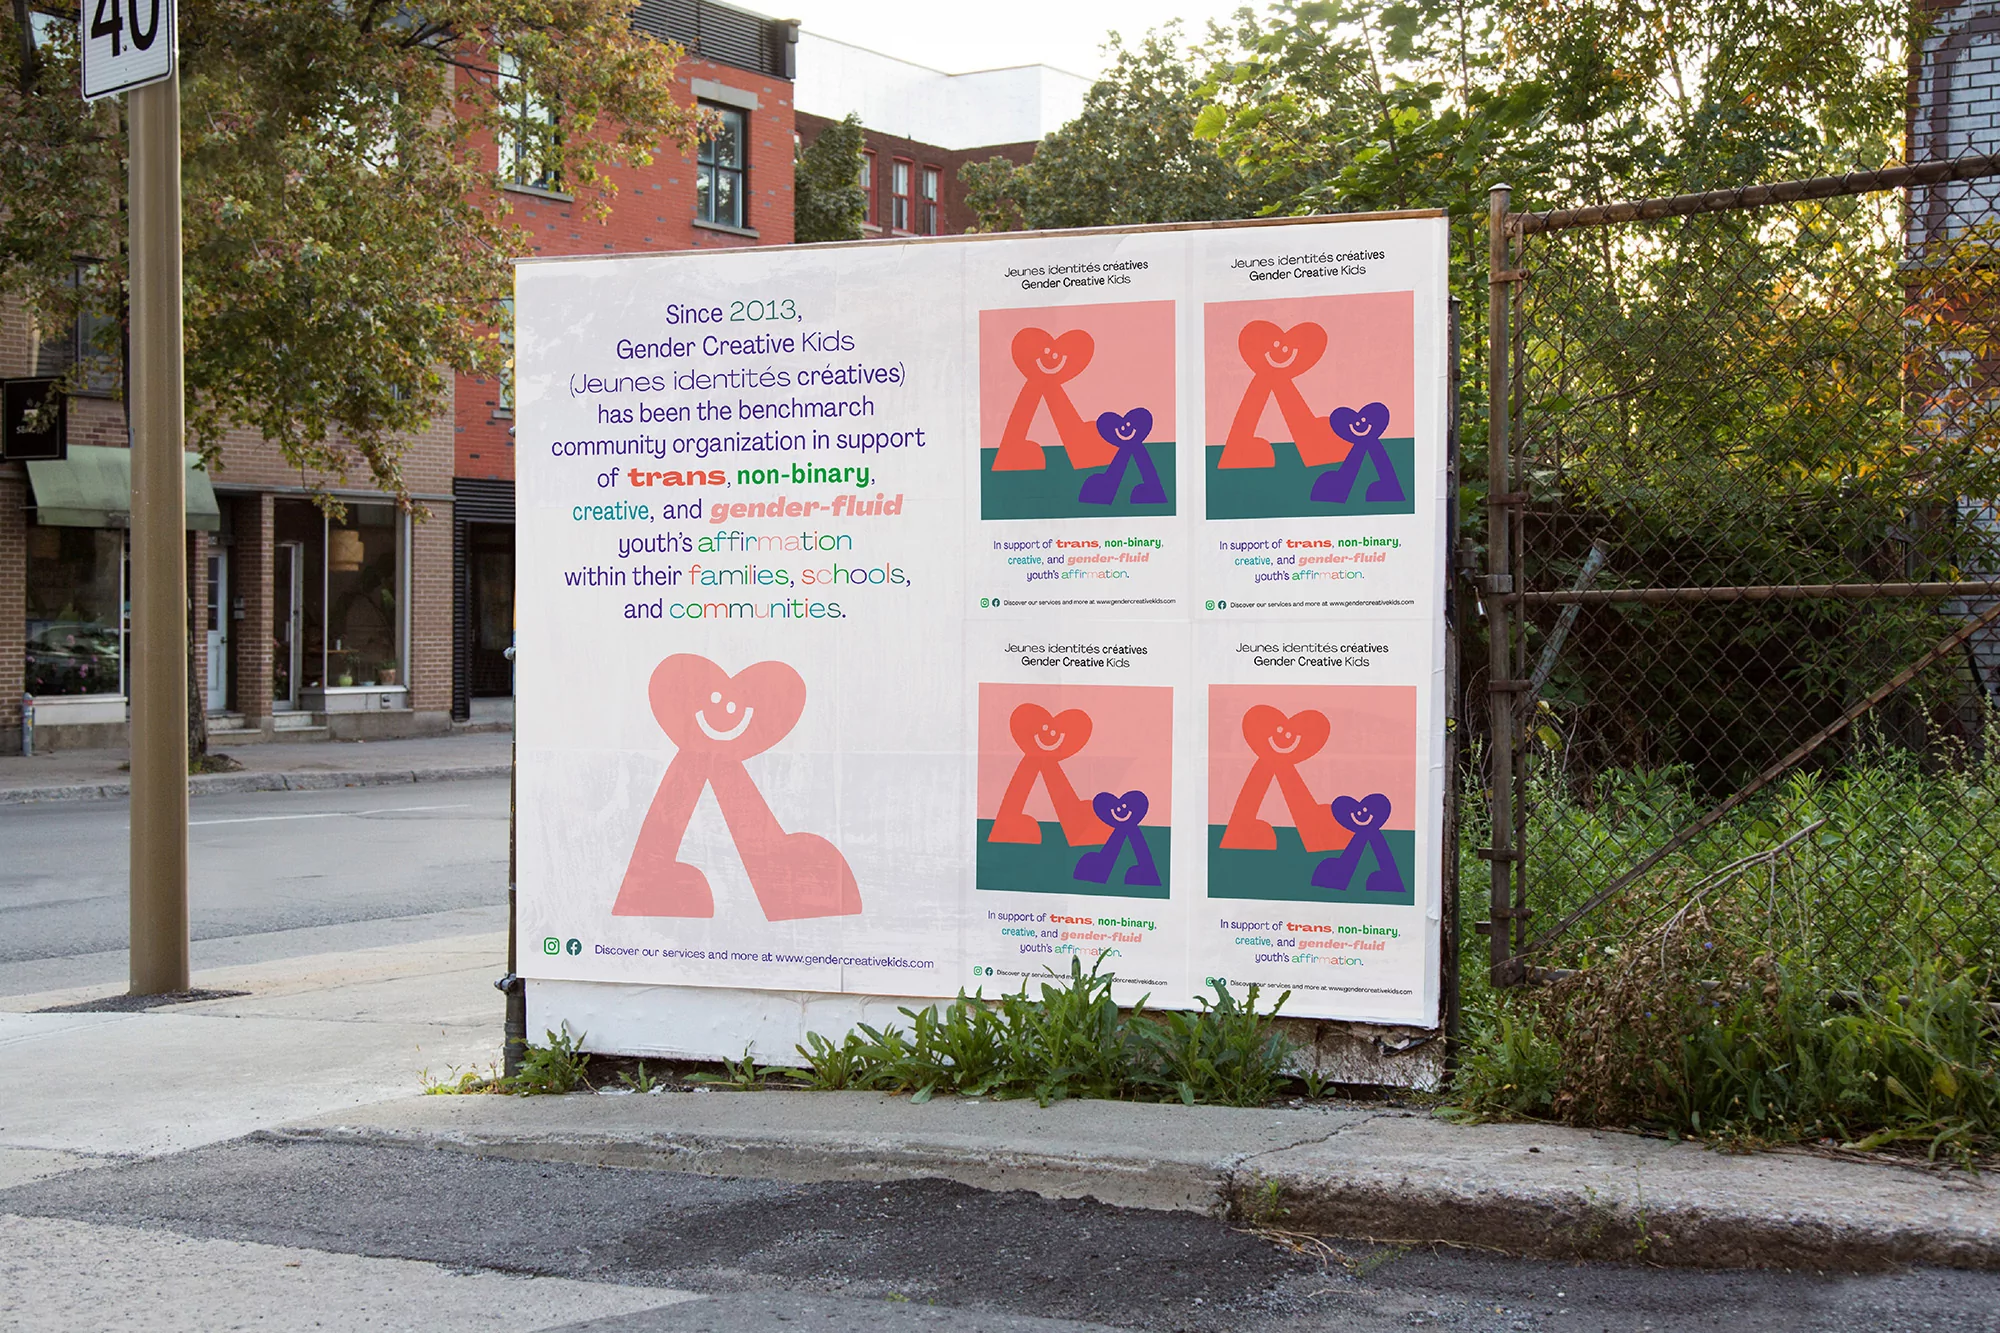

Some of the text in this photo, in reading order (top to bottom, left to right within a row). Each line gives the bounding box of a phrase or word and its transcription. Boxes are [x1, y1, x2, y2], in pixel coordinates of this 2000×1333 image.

[91, 0, 160, 57] 40
[1231, 250, 1385, 268] Jeunes identités créatives
[1004, 260, 1148, 277] Jeunes identités créatives
[1249, 264, 1366, 281] Gender Creative Kids
[1022, 274, 1131, 290] Gender Creative Kids
[666, 299, 802, 324] Since 2013,
[617, 330, 855, 359] Gender Creative Kids
[570, 361, 905, 398] (Jeunes identités créatives)
[599, 395, 874, 423] has been the benchmarch
[552, 428, 925, 459] community organization in support
[597, 462, 875, 488] of trans, non-binary,
[573, 493, 903, 524] creative, and gender-fluid
[618, 531, 852, 558] youth's affirmation
[994, 537, 1163, 551] In support of trans, non-binary,
[1220, 536, 1401, 552] In support of trans, non-binary,
[1008, 552, 1149, 566] creative, and gender-fluid
[1235, 552, 1386, 566] creative, and gender-fluid
[564, 563, 910, 588] within their families, schools,
[1027, 569, 1129, 582] youth's affirmation.
[1255, 570, 1364, 583] youth's affirmation.
[624, 598, 846, 619] and communities.
[1096, 598, 1176, 606] www.gendercreativekids.com
[1230, 601, 1255, 609] Discover
[1268, 600, 1291, 608] services
[1293, 600, 1304, 608] and
[1005, 643, 1148, 655] Jeunes identités créatives
[1236, 642, 1389, 653] Jeunes identités créatives
[1021, 656, 1130, 668] Gender Creative Kids
[1254, 656, 1370, 667] Gender Creative Kids
[988, 910, 1156, 931] In support of trans, non-binary,
[1221, 919, 1400, 938] In support of trans, non-binary,
[1002, 928, 1142, 942] creative, and gender-fluid
[1235, 936, 1385, 950] creative, and gender-fluid
[1020, 943, 1052, 954] youth's
[595, 945, 639, 955] Discover
[662, 949, 705, 959] services
[708, 950, 728, 960] and
[731, 953, 758, 961] more
[762, 953, 773, 962] at
[776, 954, 934, 969] www.gendercreativekids.com
[1255, 952, 1364, 966] youth's affirmation.
[1031, 972, 1054, 980] services
[1328, 987, 1412, 995] www.gendercreativekids.com
